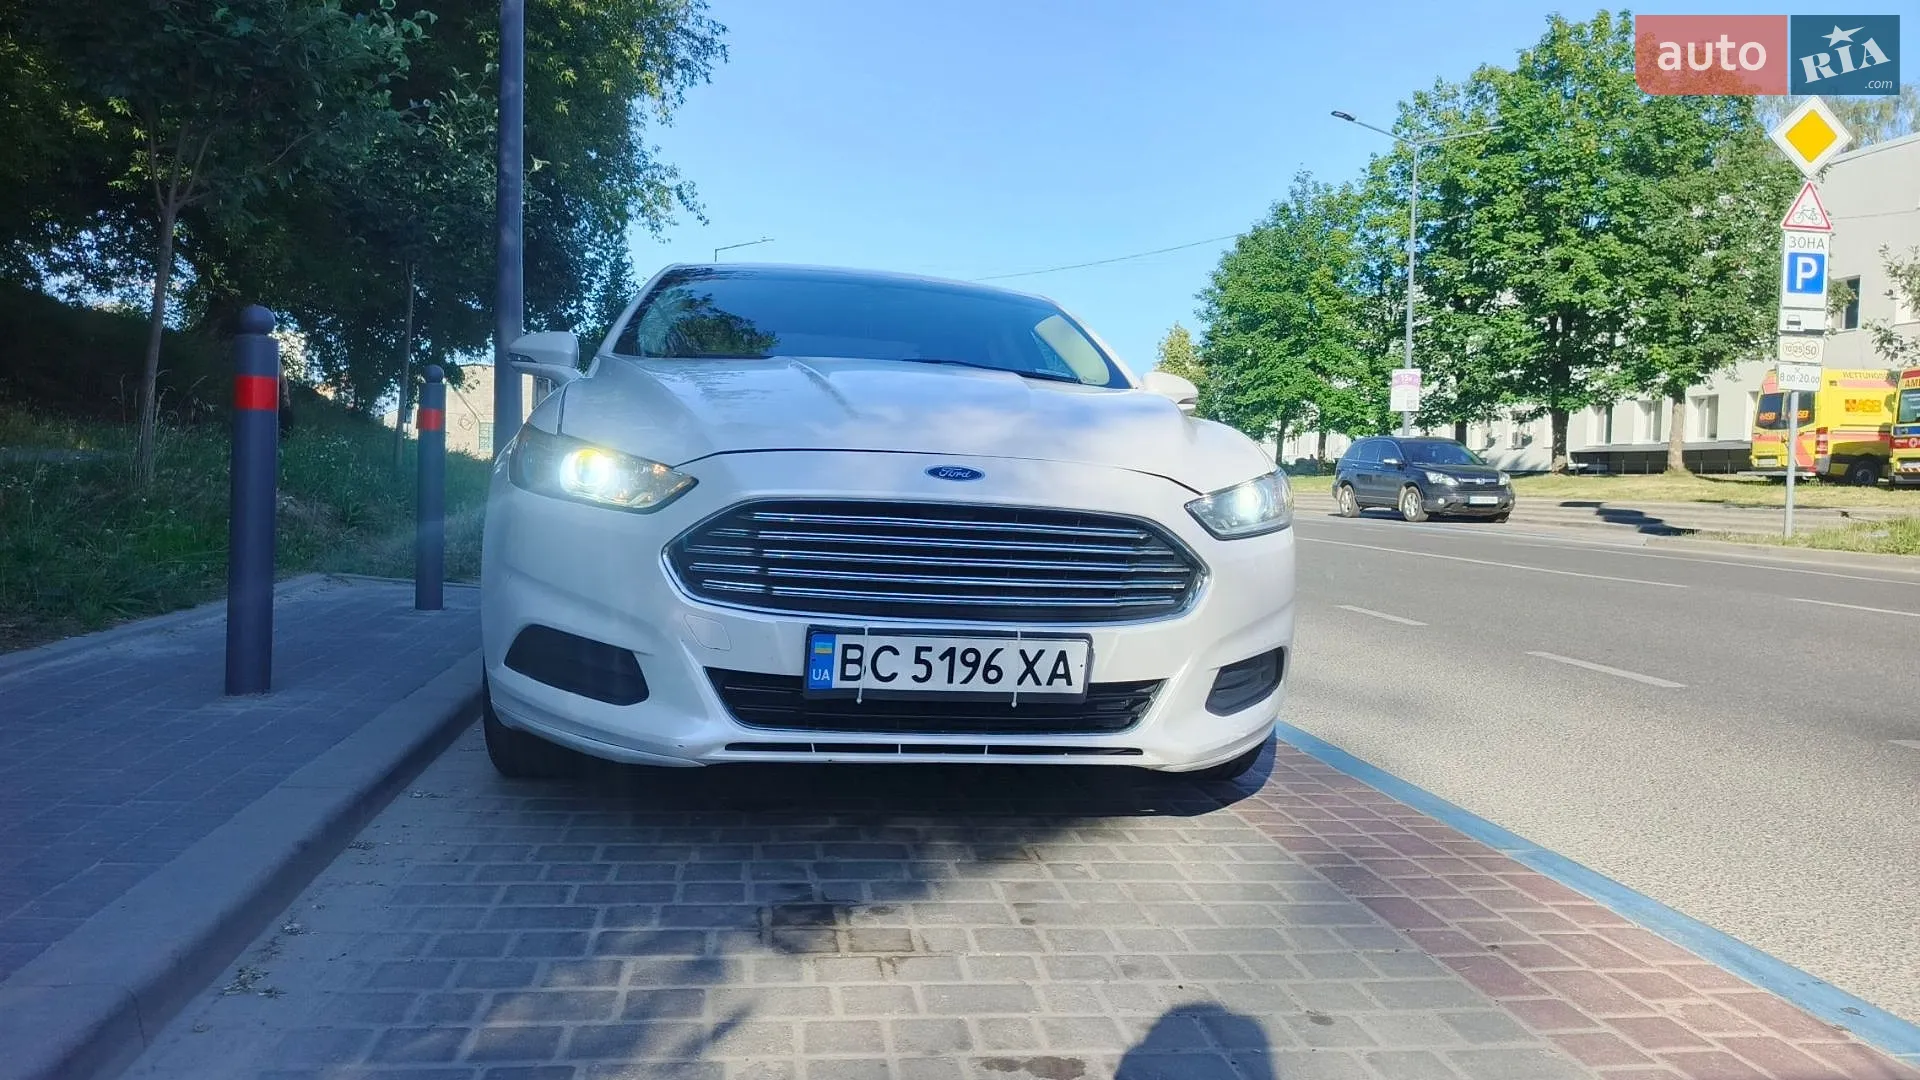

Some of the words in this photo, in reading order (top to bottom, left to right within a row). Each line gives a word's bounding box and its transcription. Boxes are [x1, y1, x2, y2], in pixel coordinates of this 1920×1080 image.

[1788, 235, 1825, 250] ЗОНА
[1796, 256, 1818, 290] P
[1805, 345, 1817, 356] 50
[938, 467, 971, 478] Ford
[839, 643, 900, 684] BC
[911, 645, 1004, 685] 5196
[1016, 649, 1073, 687] XA
[812, 668, 830, 681] UA
